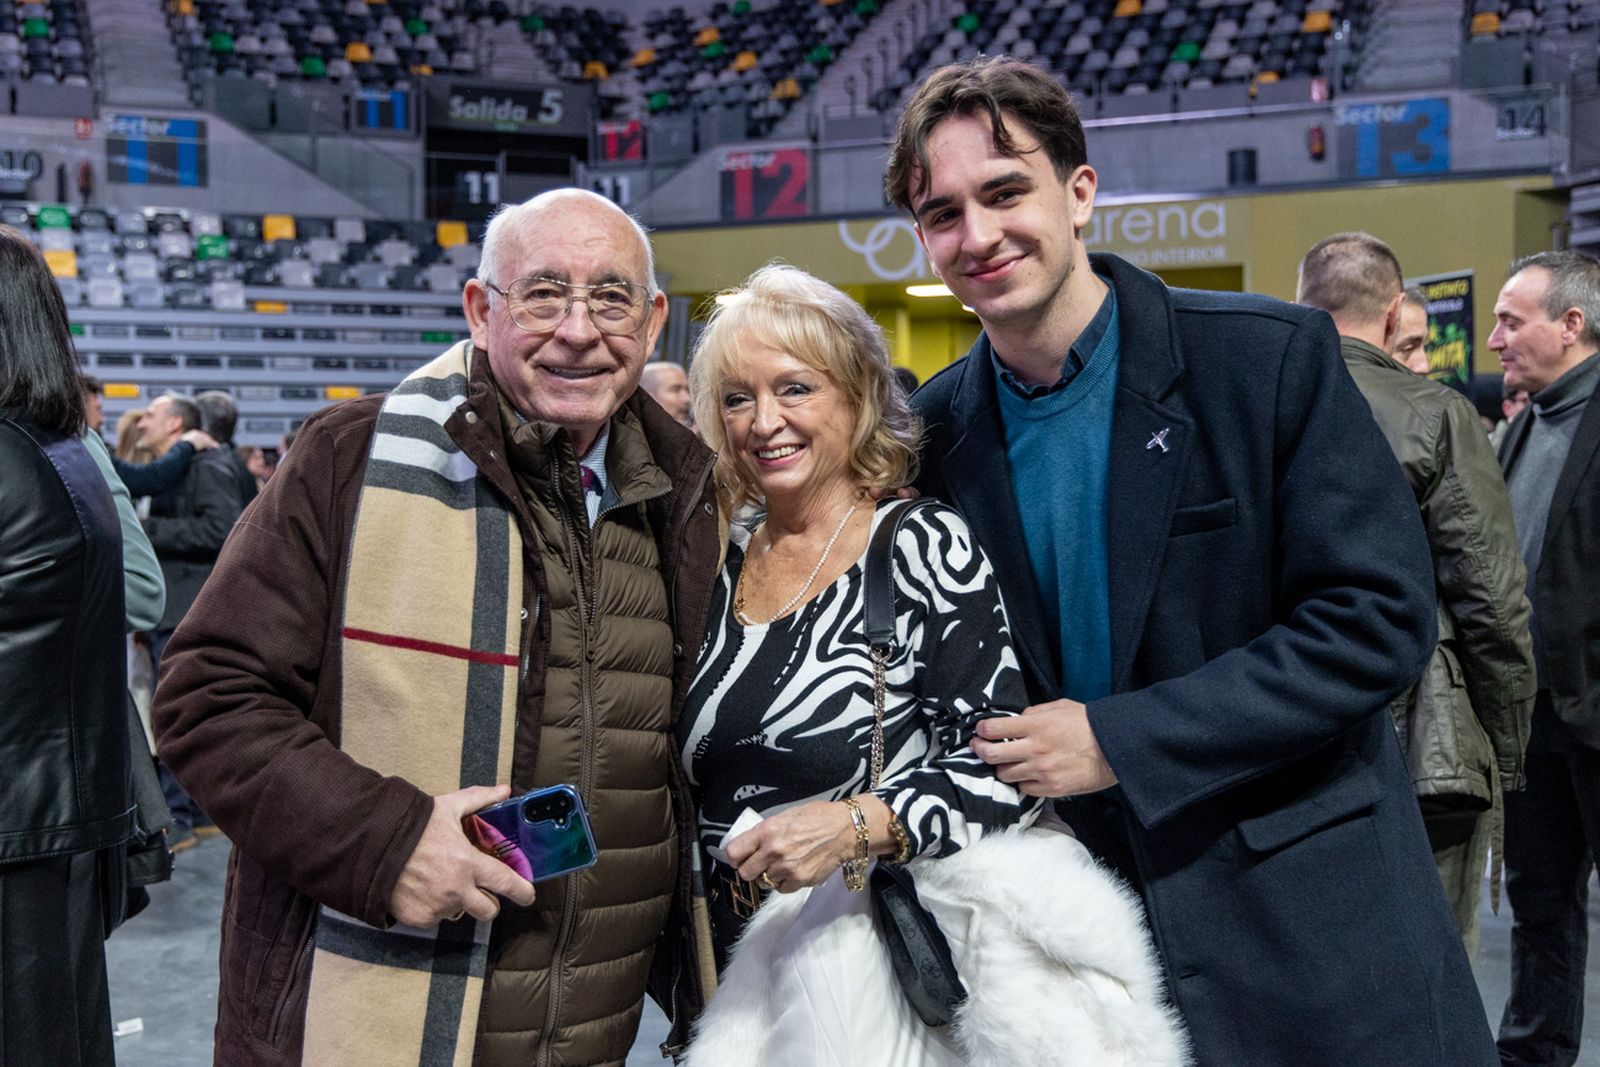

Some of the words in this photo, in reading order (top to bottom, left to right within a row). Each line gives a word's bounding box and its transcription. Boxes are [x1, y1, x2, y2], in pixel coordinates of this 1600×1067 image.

[448, 95, 528, 121] Salida
[538, 89, 562, 124] 5
[1335, 104, 1408, 125] Sector
[1505, 104, 1546, 137] 14
[105, 114, 172, 136] Sector
[606, 120, 641, 160] 12
[1346, 98, 1450, 177] 13
[116, 115, 197, 186] 11
[720, 152, 775, 171] Sector
[464, 171, 499, 204] 11
[728, 149, 808, 219] 12
[1152, 246, 1227, 264] INTERIOR
